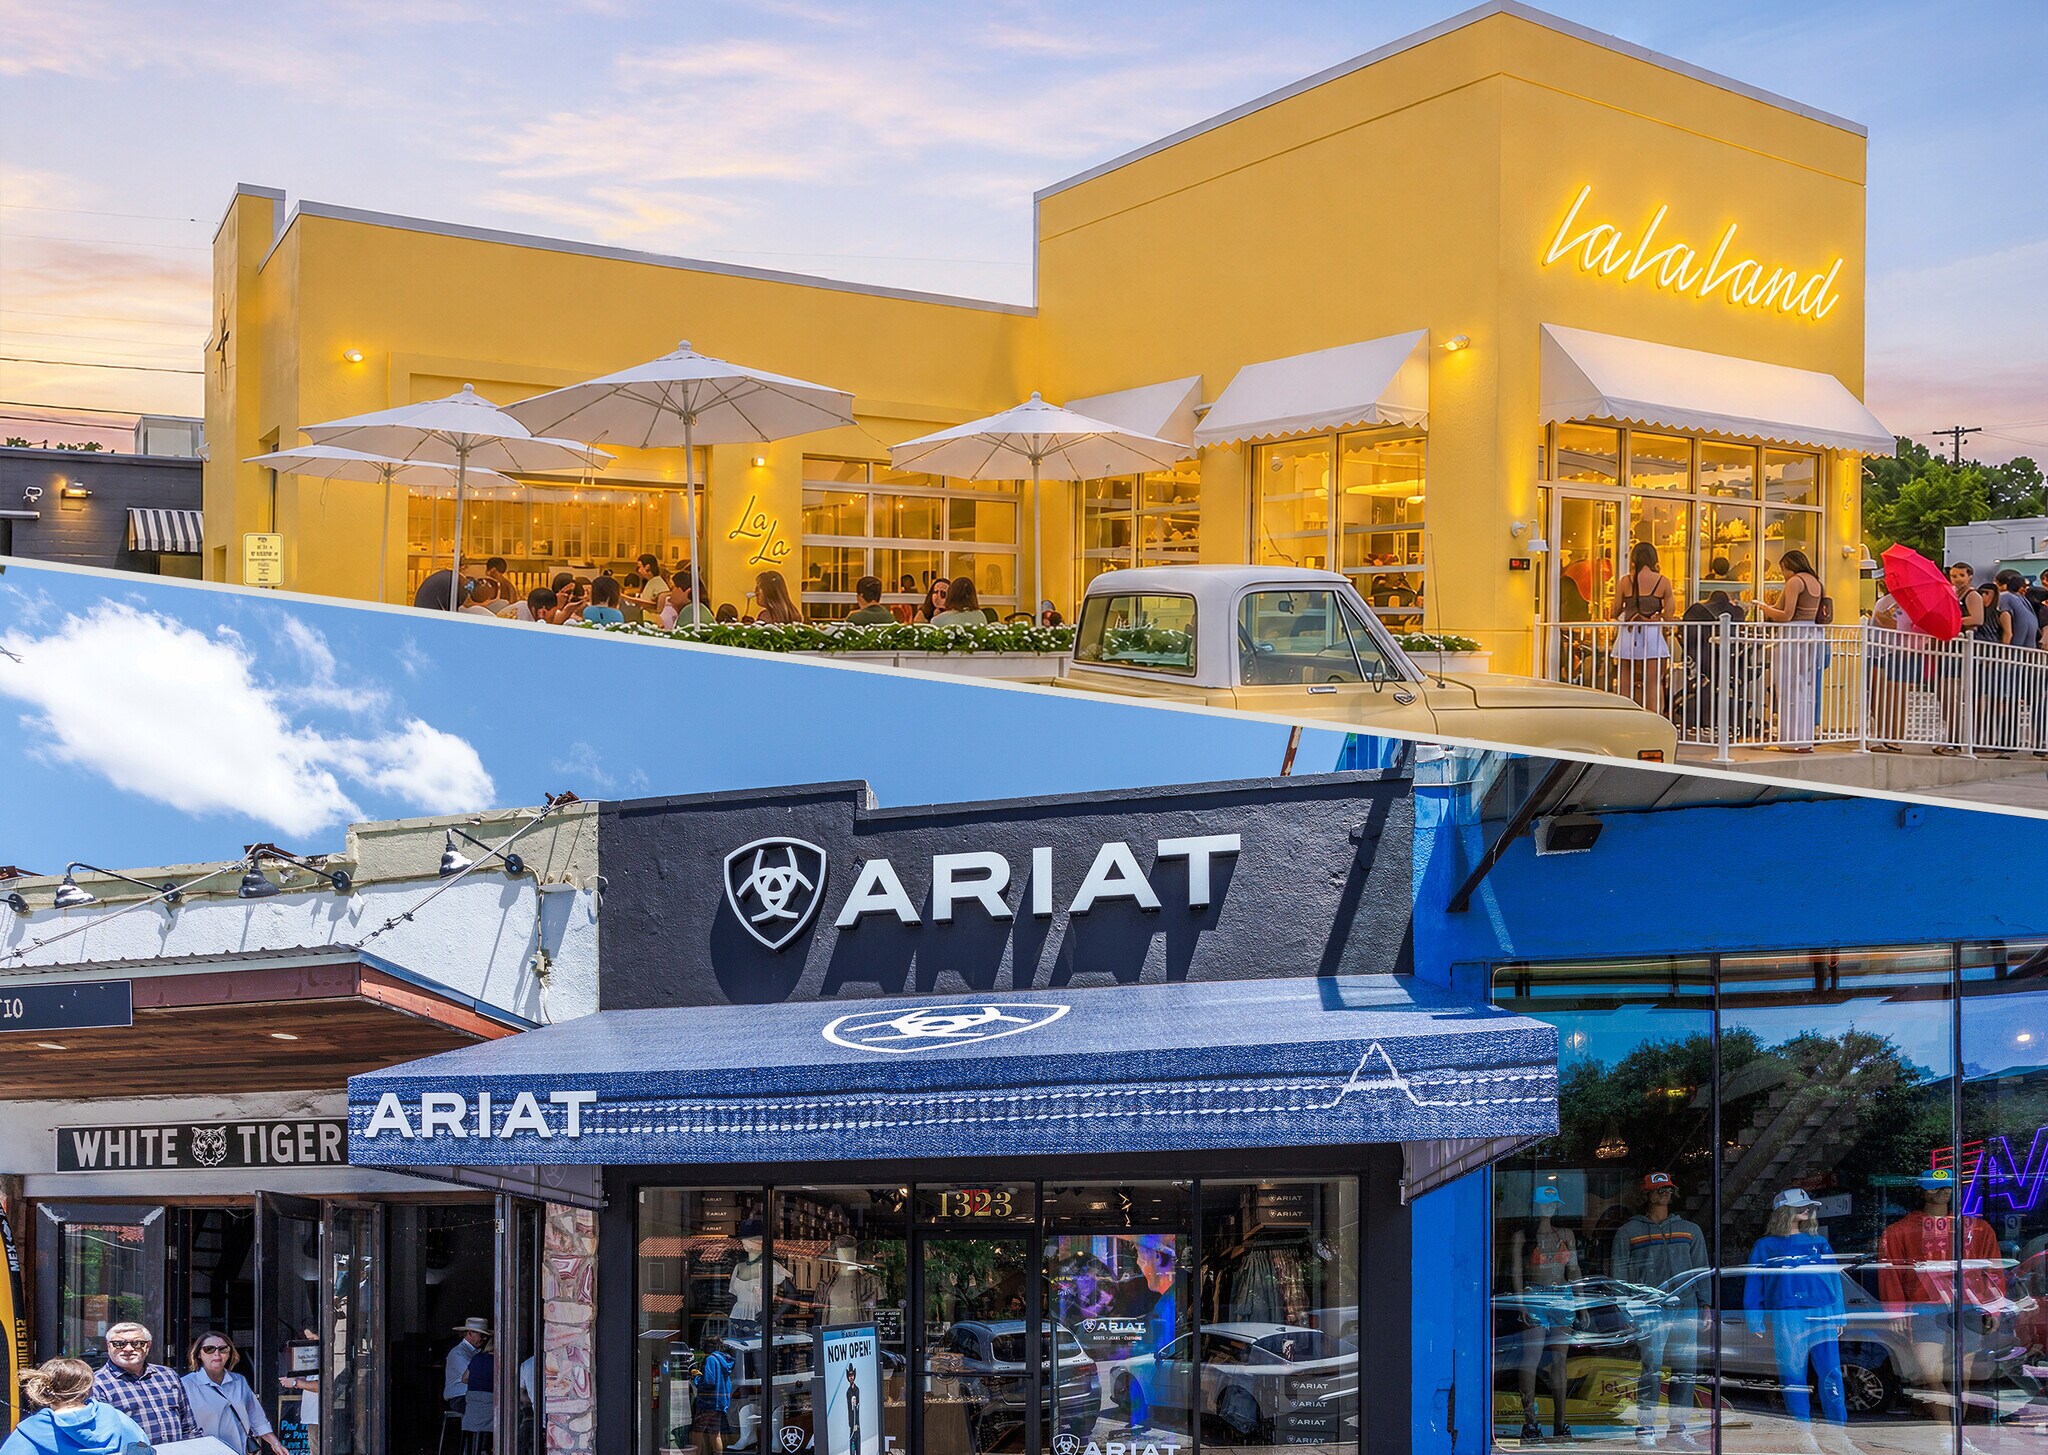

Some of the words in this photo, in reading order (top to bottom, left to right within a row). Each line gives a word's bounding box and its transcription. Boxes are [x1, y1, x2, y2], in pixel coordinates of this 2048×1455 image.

[729, 495, 768, 539] La
[749, 520, 791, 565] La
[834, 834, 1241, 930] ARIAT
[0, 997, 24, 1019] IO
[364, 1090, 598, 1139] ARIAT
[72, 1128, 179, 1168] WHITE
[237, 1123, 343, 1165] TIGER
[938, 1191, 1013, 1217] 1323
[6, 1244, 20, 1272] MEX
[16, 1319, 27, 1339] 512
[1097, 1322, 1145, 1331] ARIAT
[827, 1343, 847, 1363] NOW
[849, 1340, 872, 1360] OPEN!
[1600, 1380, 1619, 1396] jet
[281, 1420, 298, 1430] PAW
[293, 1431, 308, 1439] PAT
[1083, 1441, 1181, 1455] ARIAT
